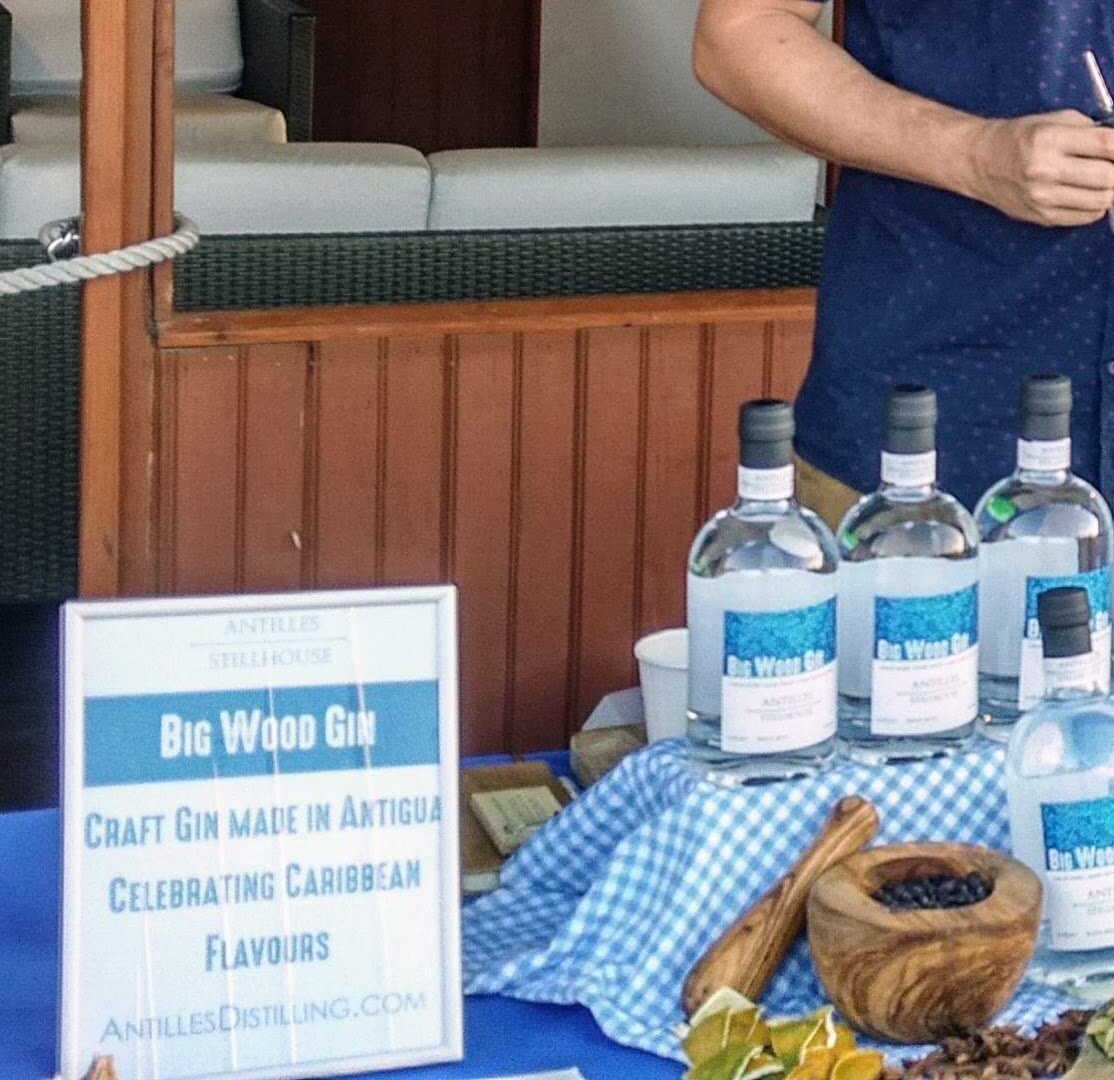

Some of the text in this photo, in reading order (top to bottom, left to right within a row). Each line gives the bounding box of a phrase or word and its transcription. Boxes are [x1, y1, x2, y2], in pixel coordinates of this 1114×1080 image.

[224, 615, 320, 635] ANTILLES
[208, 647, 332, 670] STILLHOUSE
[160, 704, 376, 759] BIG WOOD GIN
[84, 794, 443, 849] CRAFT GIN MADE IN ANTIGUA
[108, 859, 422, 914] CELEBRATING CARIBBEAN
[205, 931, 330, 972] FLAVOURS
